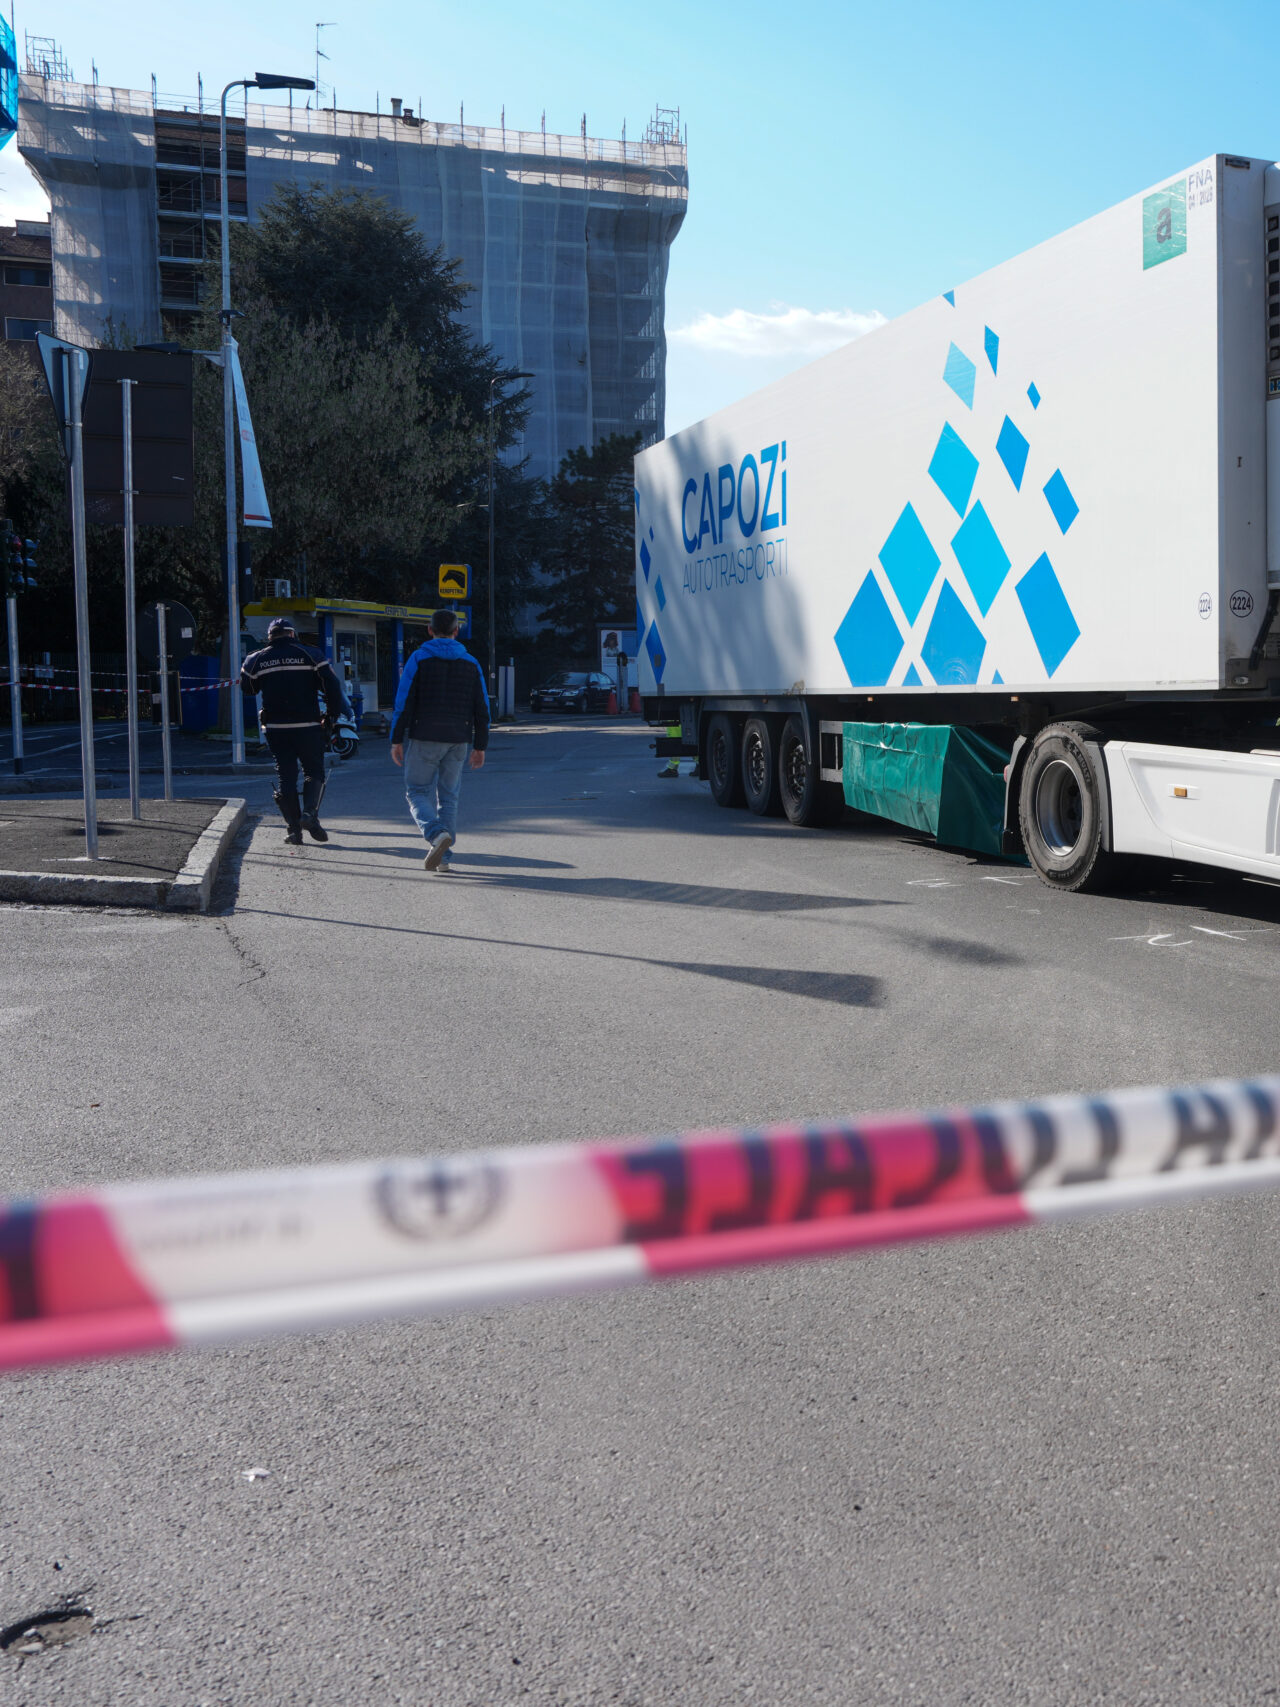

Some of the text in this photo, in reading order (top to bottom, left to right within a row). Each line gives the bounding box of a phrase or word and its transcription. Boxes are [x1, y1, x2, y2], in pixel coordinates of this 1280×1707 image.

[1188, 168, 1213, 193] FNA
[683, 537, 788, 593] AUTOTRASPORTI
[1232, 597, 1251, 610] 2224
[260, 657, 305, 669] POLIZIA LOCALE
